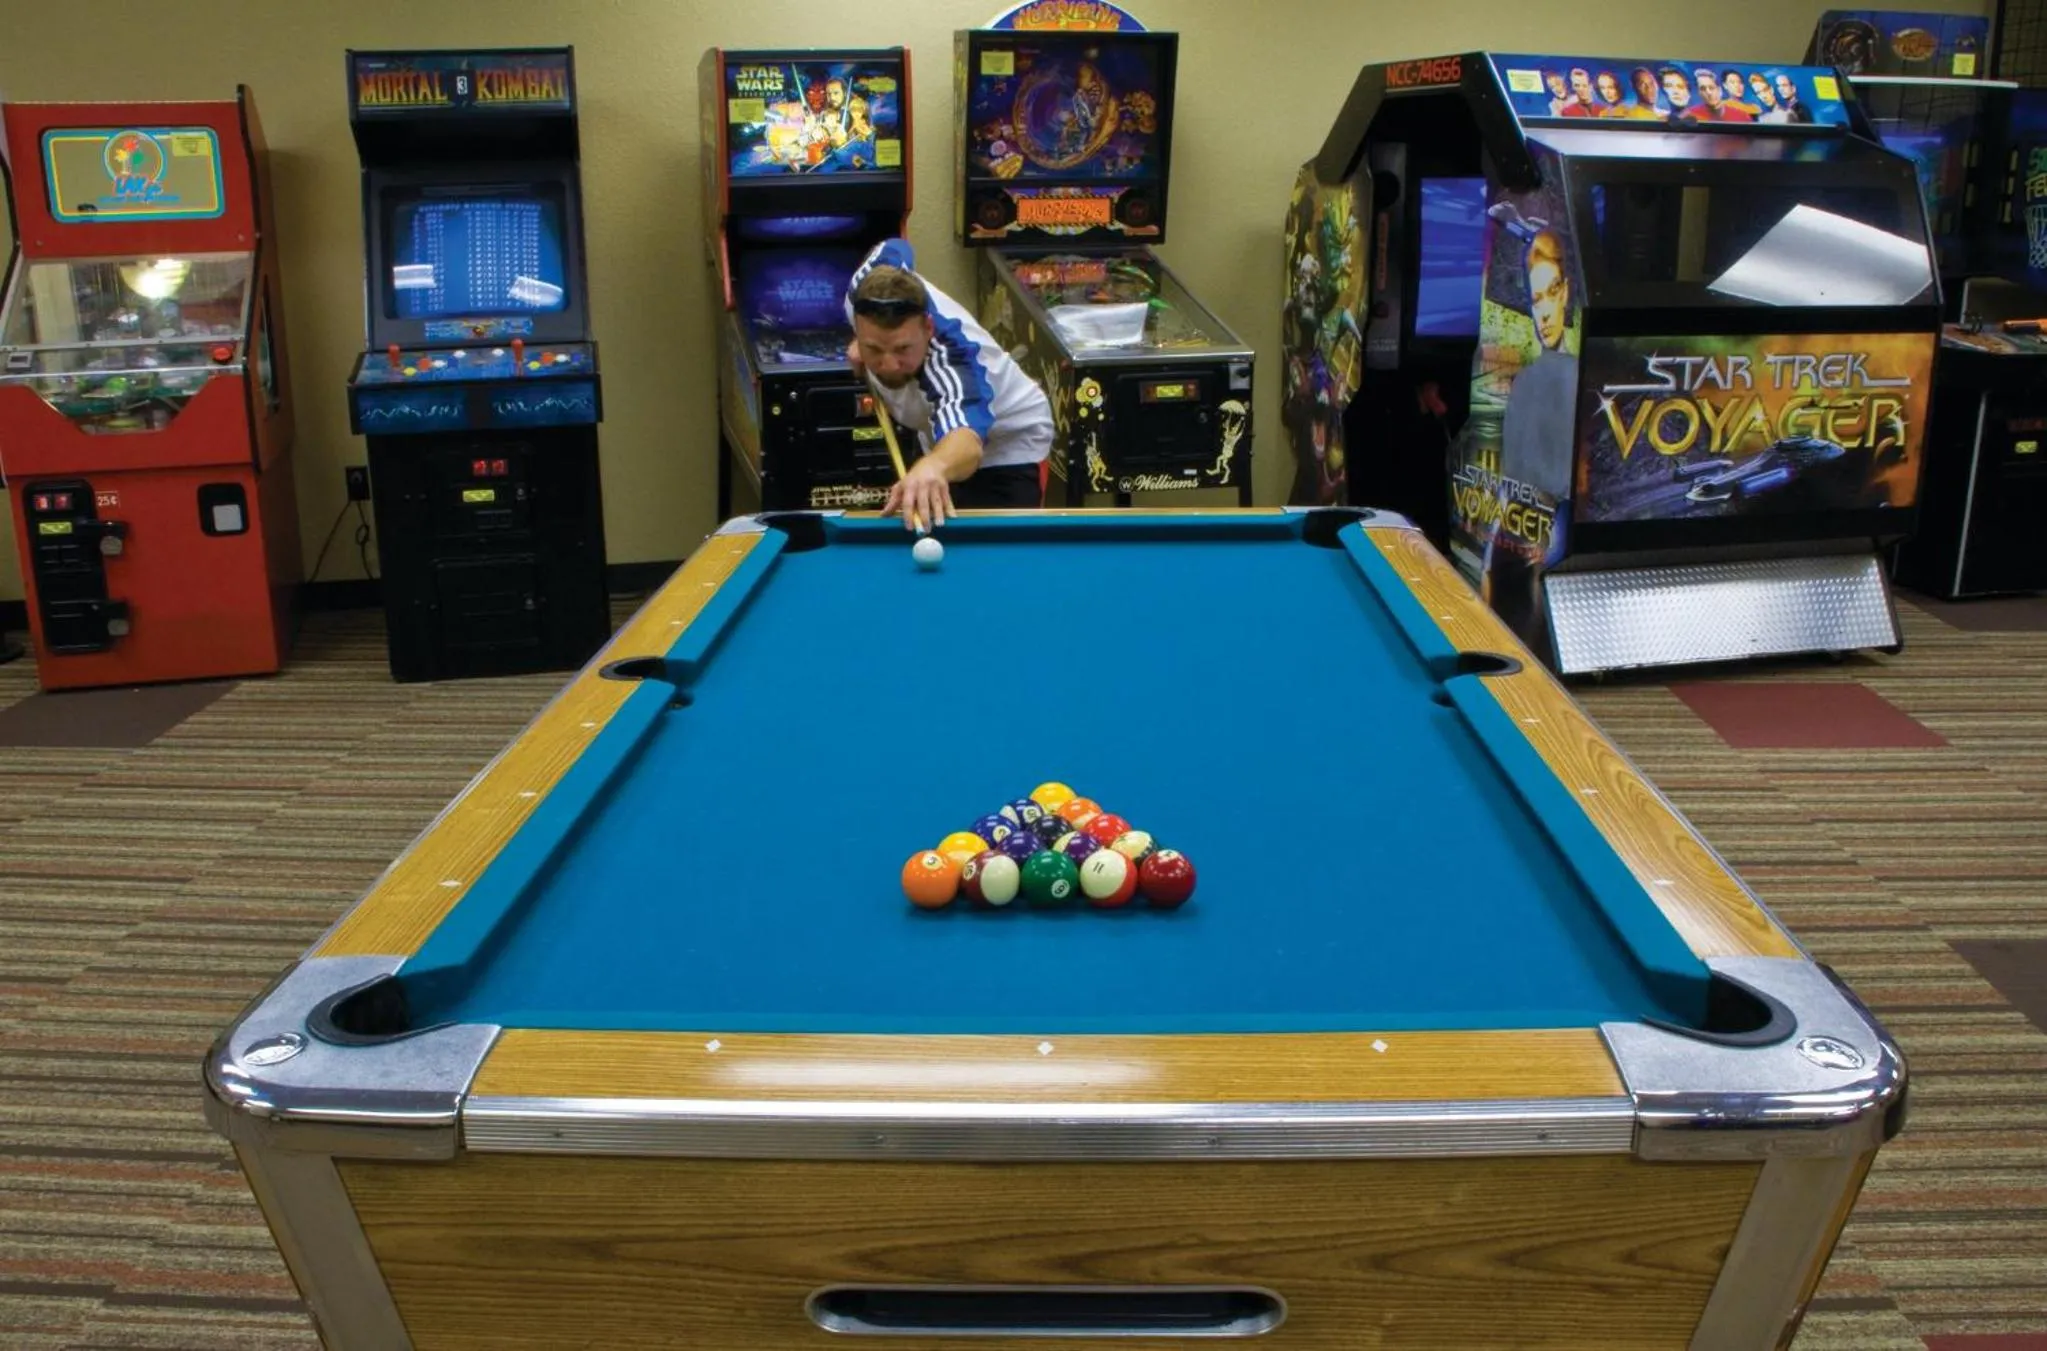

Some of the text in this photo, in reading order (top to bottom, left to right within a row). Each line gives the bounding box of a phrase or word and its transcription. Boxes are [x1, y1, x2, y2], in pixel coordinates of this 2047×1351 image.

[358, 66, 567, 105] MORTAL 3 KOMBAT
[736, 66, 785, 78] STAR
[736, 79, 785, 91] WARS
[1603, 353, 1911, 392] STAR TREK
[1601, 393, 1908, 459] VOYAGER
[1135, 474, 1198, 491] Williams
[1453, 464, 1555, 513] STAR TREK
[1453, 481, 1555, 549] VOYAGER
